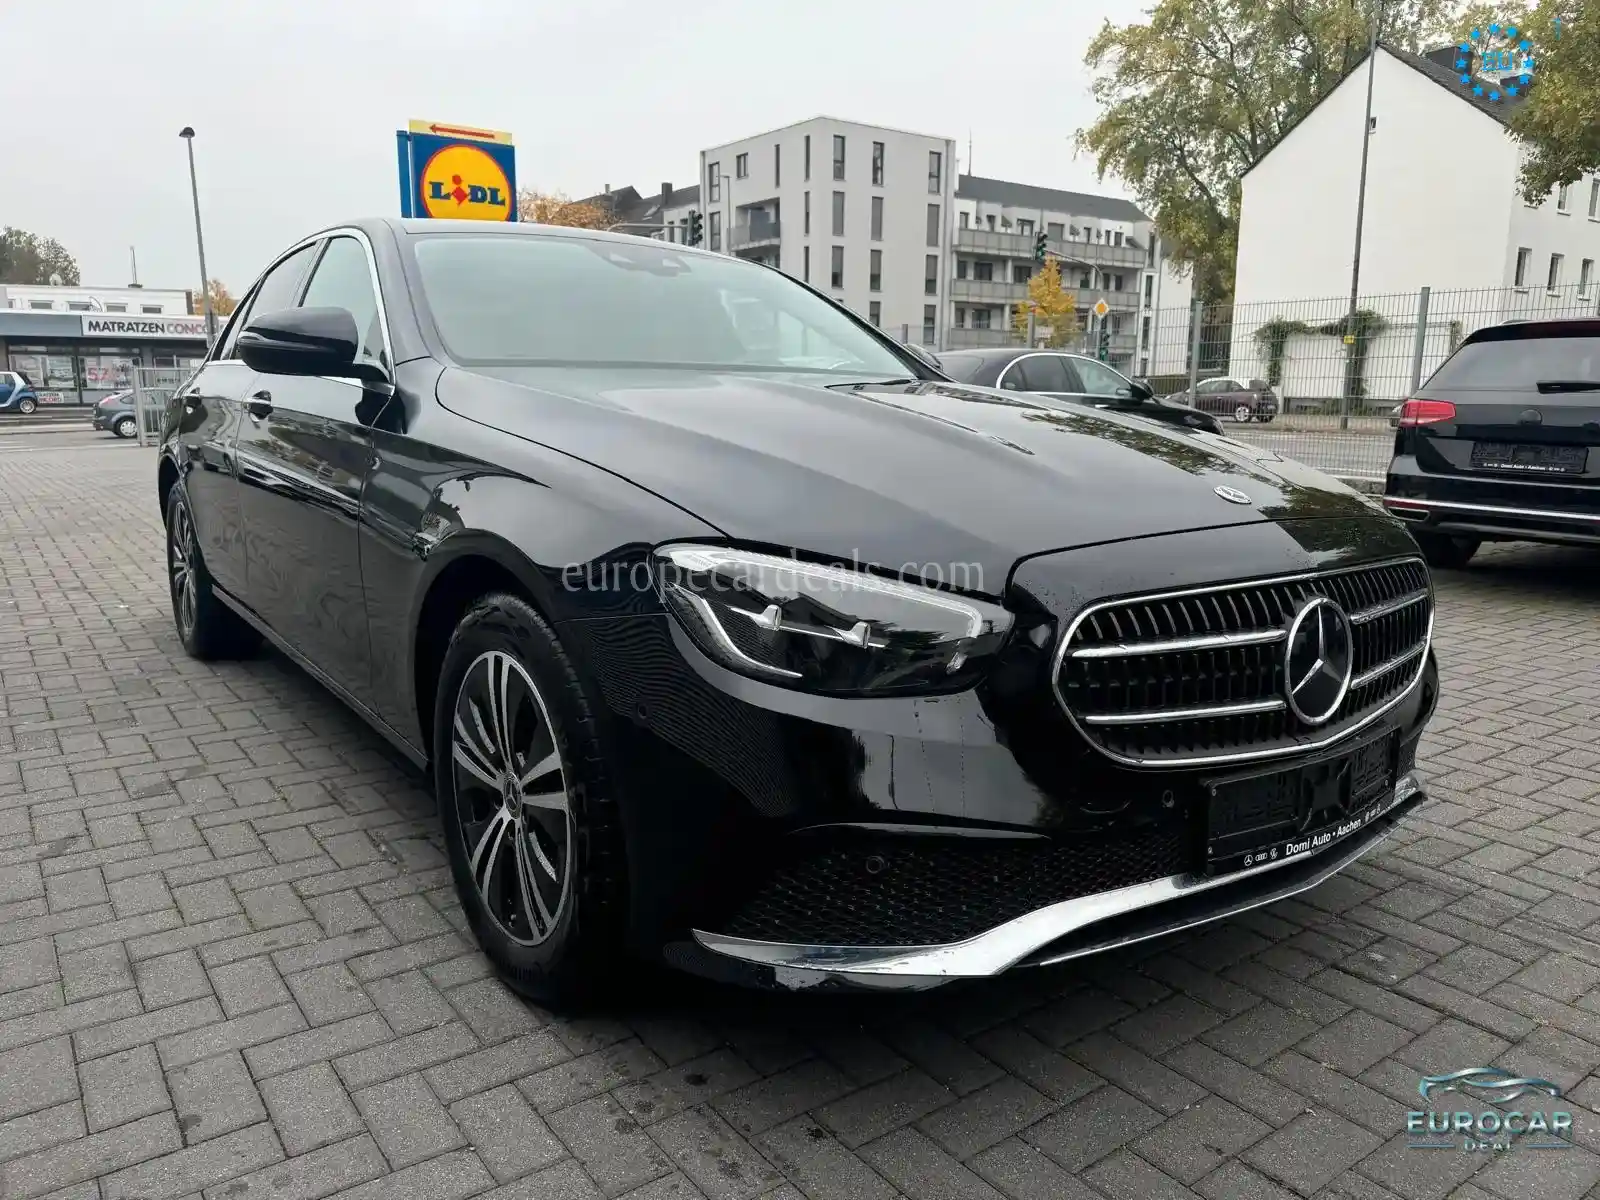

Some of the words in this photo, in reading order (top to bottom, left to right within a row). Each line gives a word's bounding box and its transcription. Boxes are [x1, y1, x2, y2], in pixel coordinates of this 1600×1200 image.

[88, 320, 165, 334] MATRATZEN
[1285, 838, 1310, 855] Domi
[1312, 834, 1331, 848] Auto
[1336, 818, 1361, 837] Aachen
